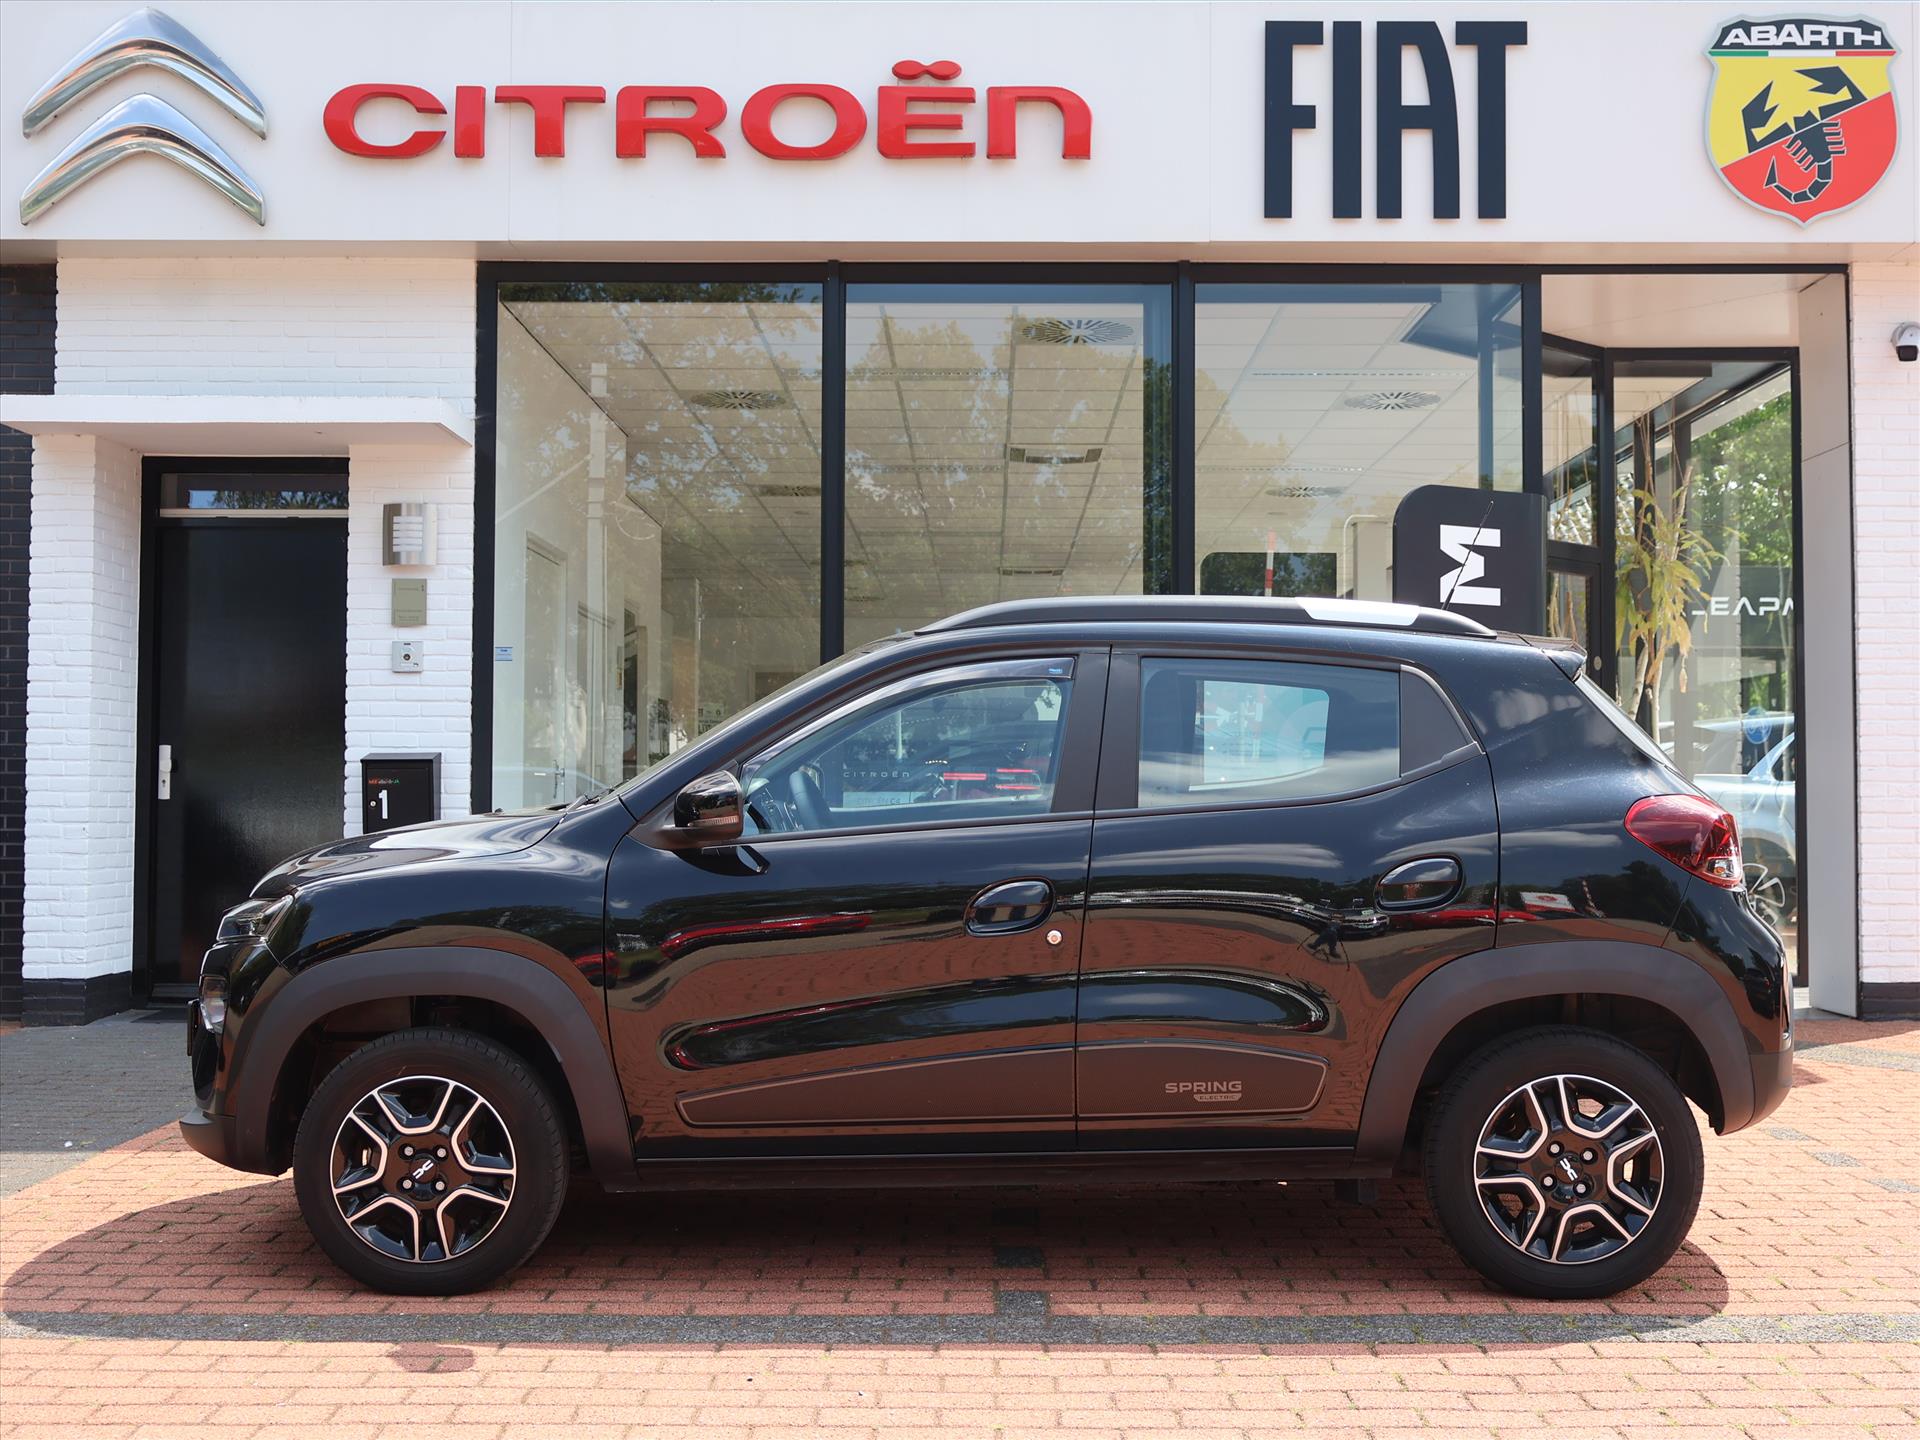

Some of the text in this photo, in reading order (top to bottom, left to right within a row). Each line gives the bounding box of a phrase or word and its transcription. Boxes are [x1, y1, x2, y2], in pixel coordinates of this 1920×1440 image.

[1721, 23, 1882, 46] ABARTH
[323, 59, 1093, 160] CITROËN
[1264, 20, 1528, 219] FIAT
[378, 789, 389, 820] 1
[1164, 1080, 1242, 1093] SPRING
